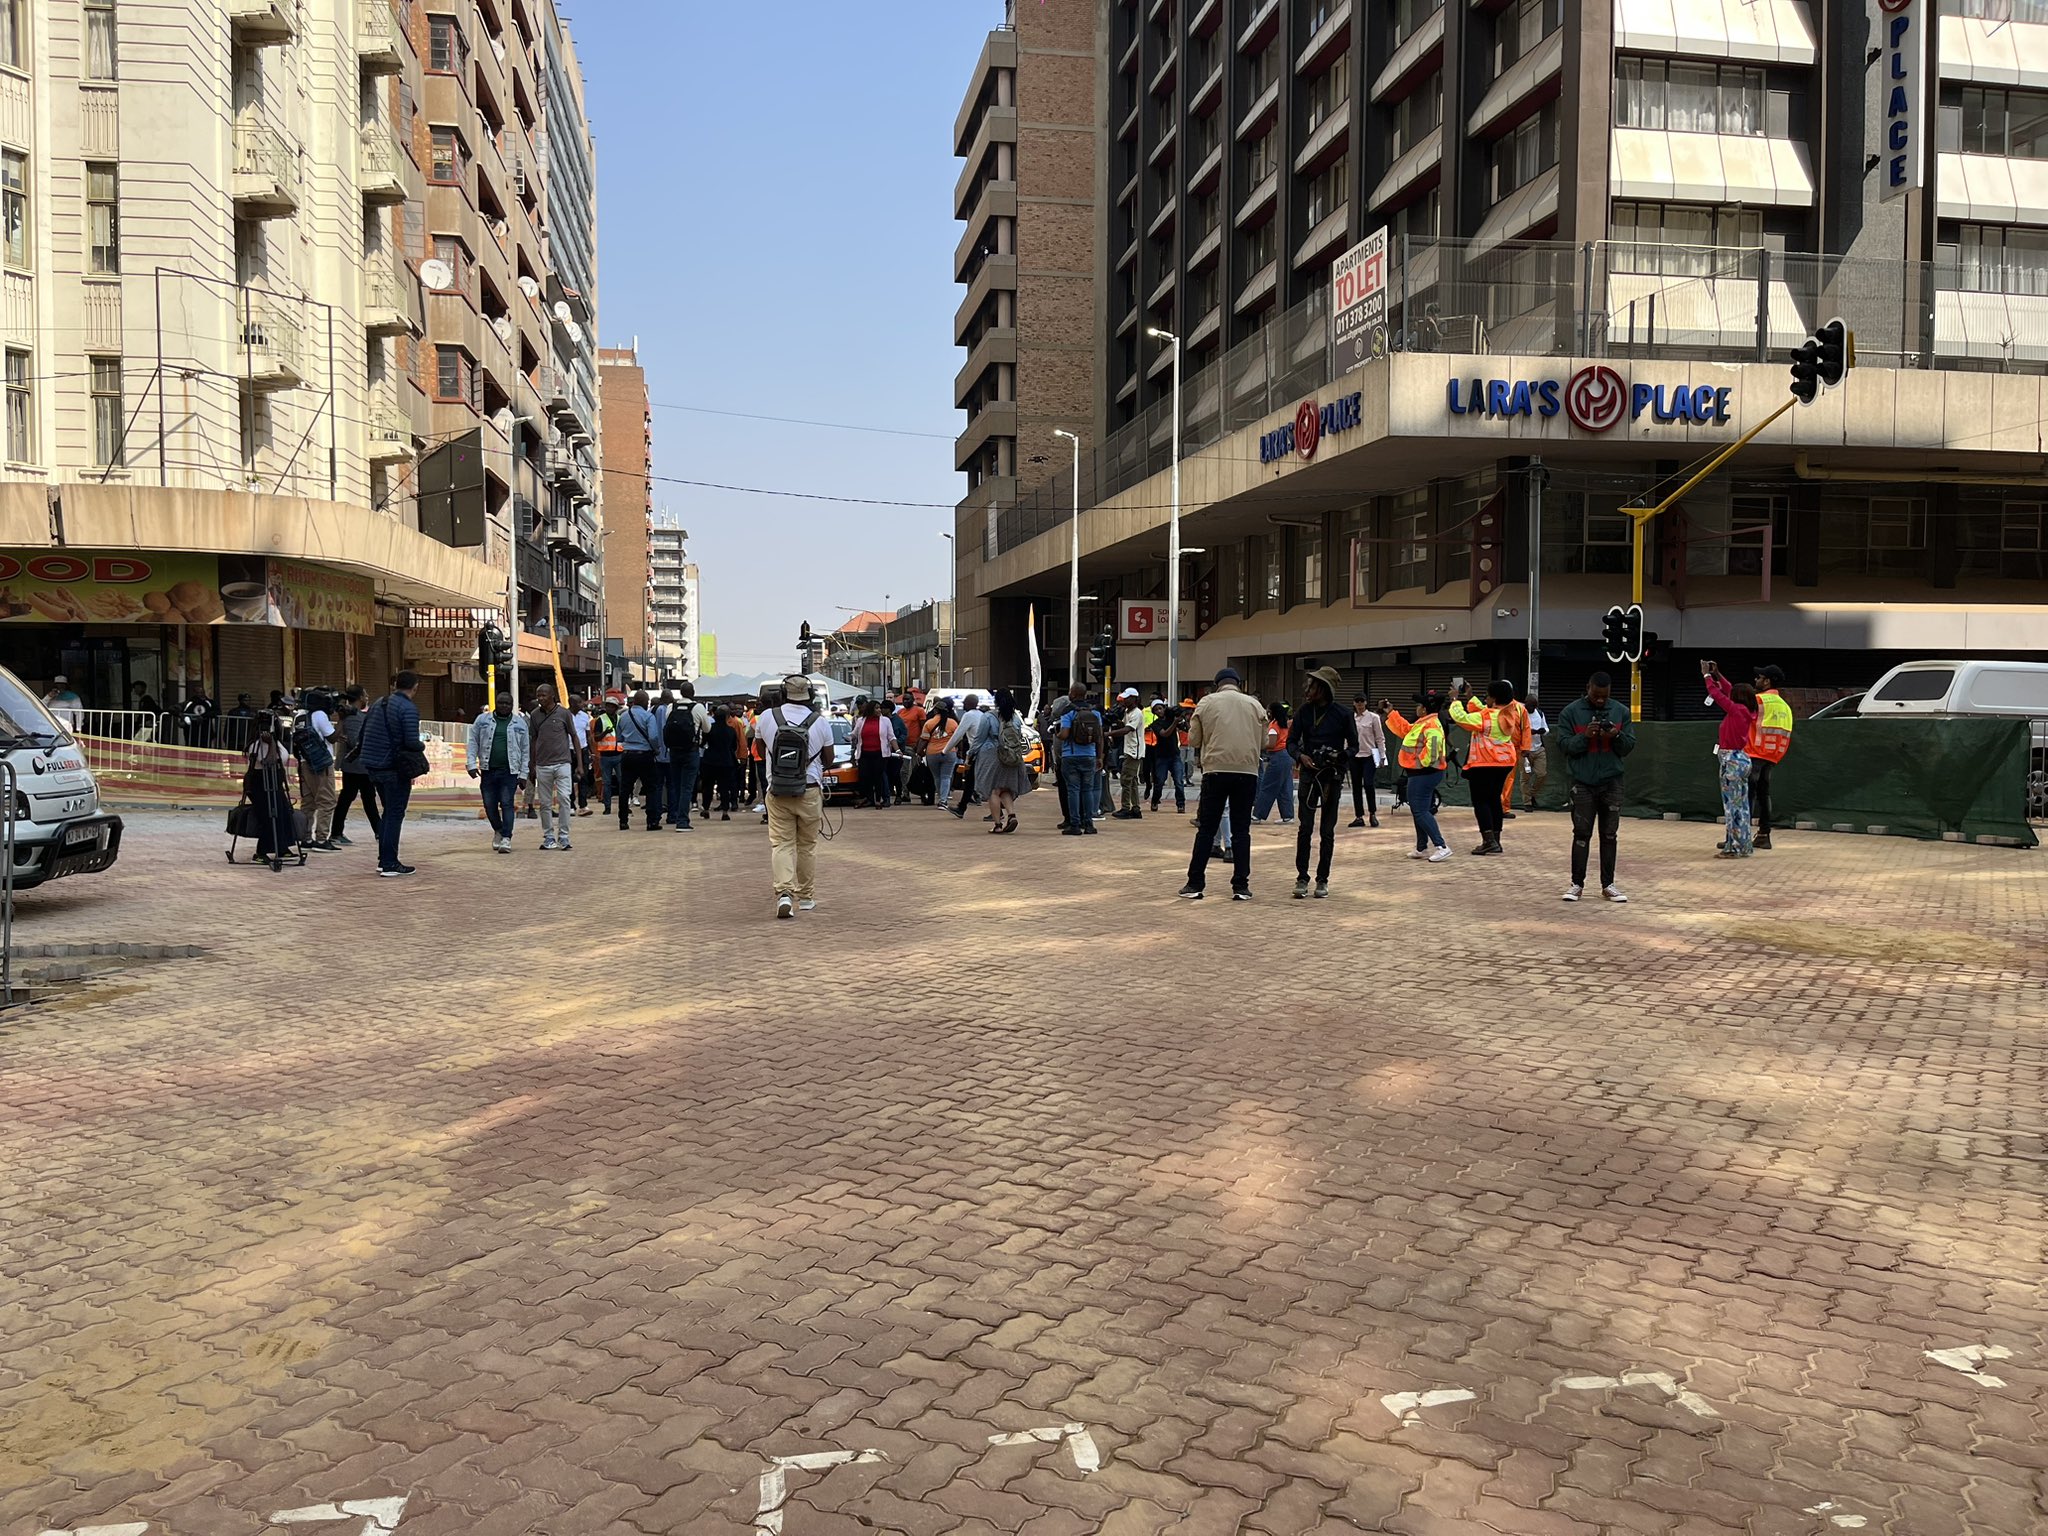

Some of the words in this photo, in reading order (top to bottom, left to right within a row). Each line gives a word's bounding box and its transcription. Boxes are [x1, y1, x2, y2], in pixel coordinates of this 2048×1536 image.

[1888, 16, 1909, 187] PLACE
[1335, 233, 1383, 279] APARTMENTS
[1335, 271, 1355, 311] TO
[1357, 250, 1383, 299] LET
[1336, 314, 1350, 335] 011
[1350, 304, 1363, 329] 378
[1363, 294, 1382, 320] 3200
[1319, 391, 1362, 438] PLACE
[1449, 378, 1560, 417] LARA'S
[1631, 383, 1732, 423] PLACE
[1157, 608, 1188, 617] spdy
[1157, 615, 1182, 624] los
[424, 638, 476, 649] CENTRE
[62, 799, 86, 812] JAC
